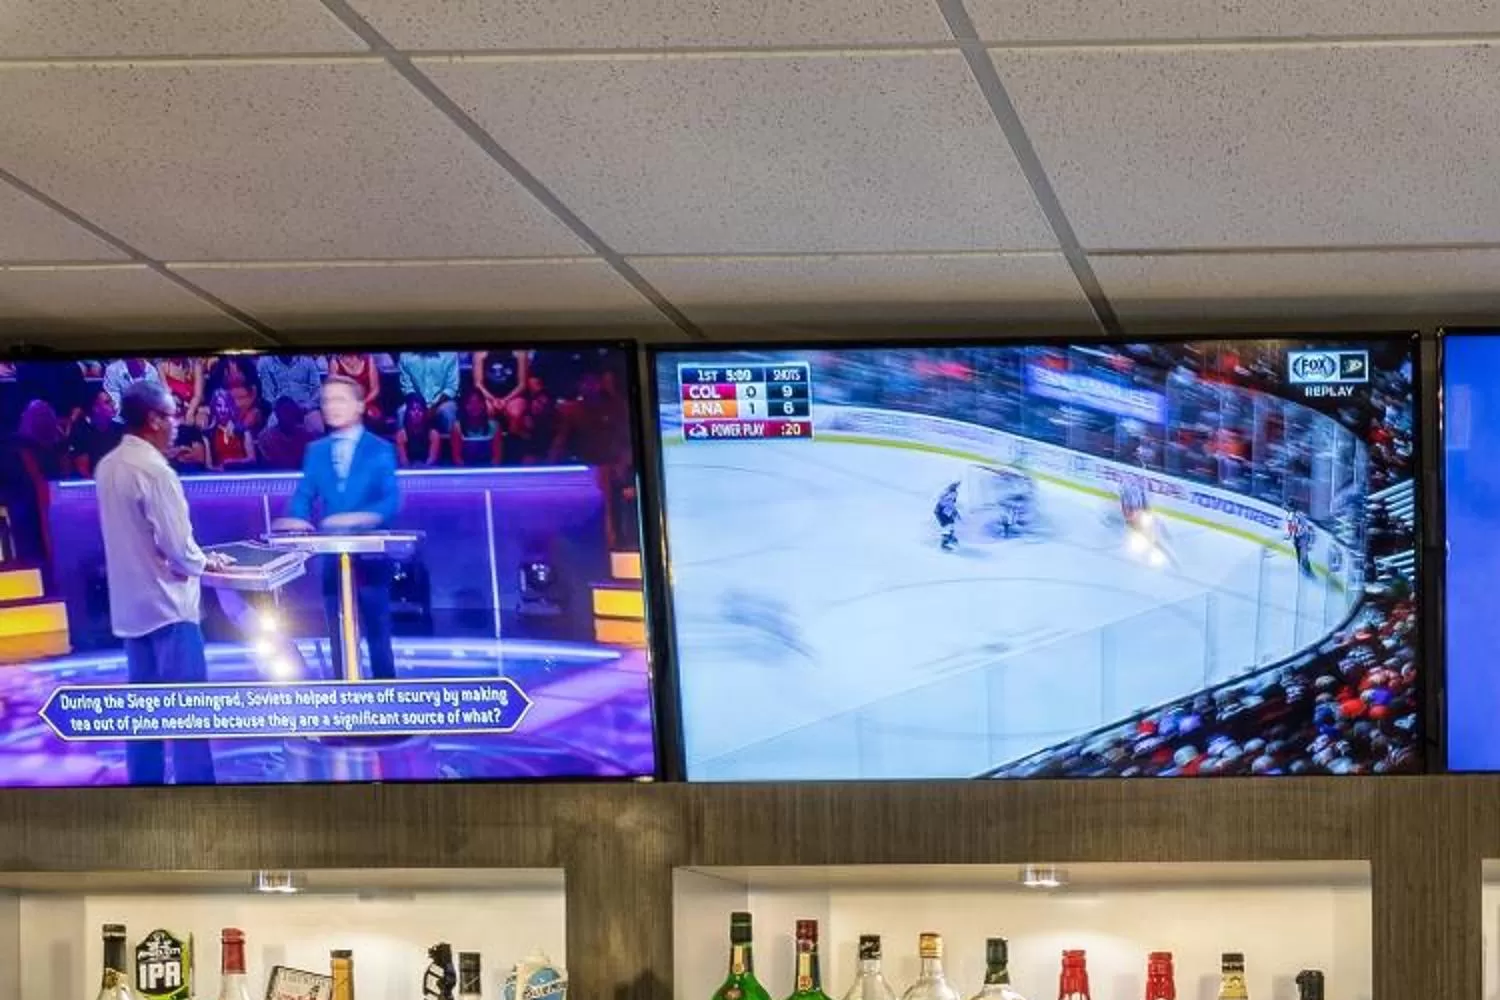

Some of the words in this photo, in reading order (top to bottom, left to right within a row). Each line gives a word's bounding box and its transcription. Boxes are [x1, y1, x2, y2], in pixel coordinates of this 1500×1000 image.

[1301, 359, 1326, 370] FOX
[689, 385, 720, 399] COL
[746, 385, 757, 399] 0
[782, 385, 793, 398] 9
[1305, 386, 1354, 397] REPLAY
[691, 402, 724, 416] ANA
[783, 402, 794, 415] 6
[61, 694, 102, 713] During
[104, 694, 124, 709] the
[127, 694, 161, 712] Siege
[163, 693, 176, 708] of
[178, 692, 245, 711] Leningrad,
[247, 692, 293, 707] Soviets
[295, 688, 337, 708] helped
[340, 689, 375, 704] stave
[377, 688, 395, 703] off
[398, 690, 441, 707] scurvy
[443, 688, 459, 706] by
[461, 686, 509, 706] making
[70, 718, 91, 731] tea
[94, 717, 114, 730] out
[117, 716, 130, 730] of
[132, 716, 159, 734] pine
[161, 714, 211, 730] needles
[213, 713, 265, 729] because
[267, 713, 297, 732] they
[300, 714, 319, 727] are
[322, 714, 331, 726] a
[333, 710, 400, 730] significant
[401, 711, 444, 725] source
[447, 708, 461, 723] of
[462, 707, 502, 724] what?
[138, 961, 181, 991] IPA
